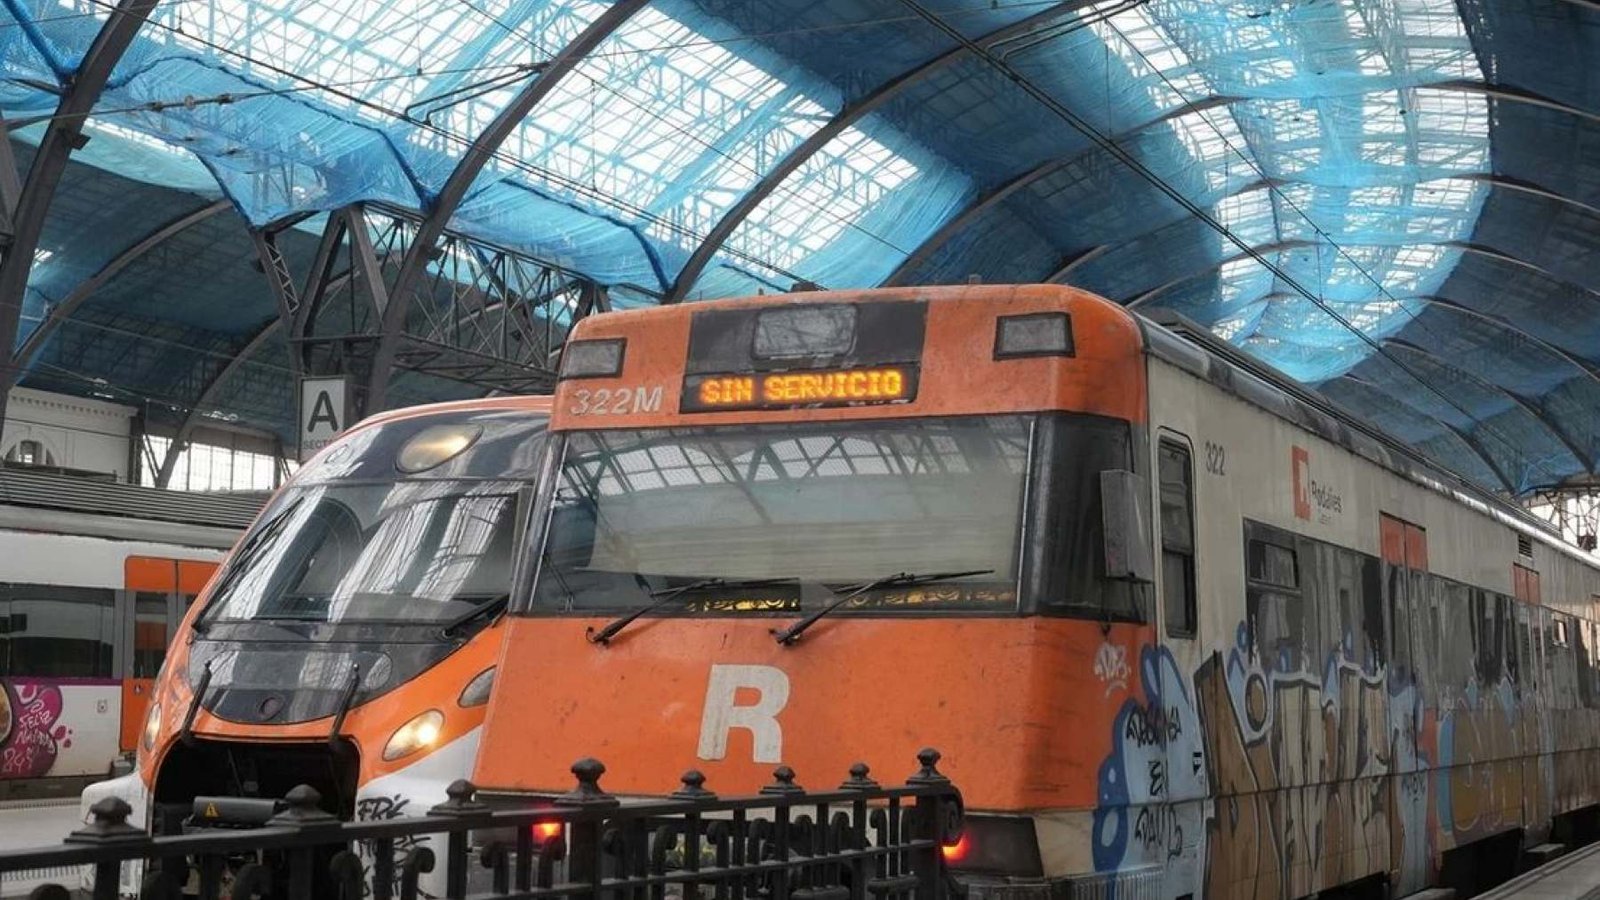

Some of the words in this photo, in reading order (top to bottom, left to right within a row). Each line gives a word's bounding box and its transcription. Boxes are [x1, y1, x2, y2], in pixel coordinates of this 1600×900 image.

[571, 386, 663, 415] 322M
[702, 377, 752, 404] SIN
[763, 369, 901, 401] SERVICIO
[308, 390, 338, 432] A
[1205, 440, 1225, 476] 322
[697, 664, 790, 764] R
